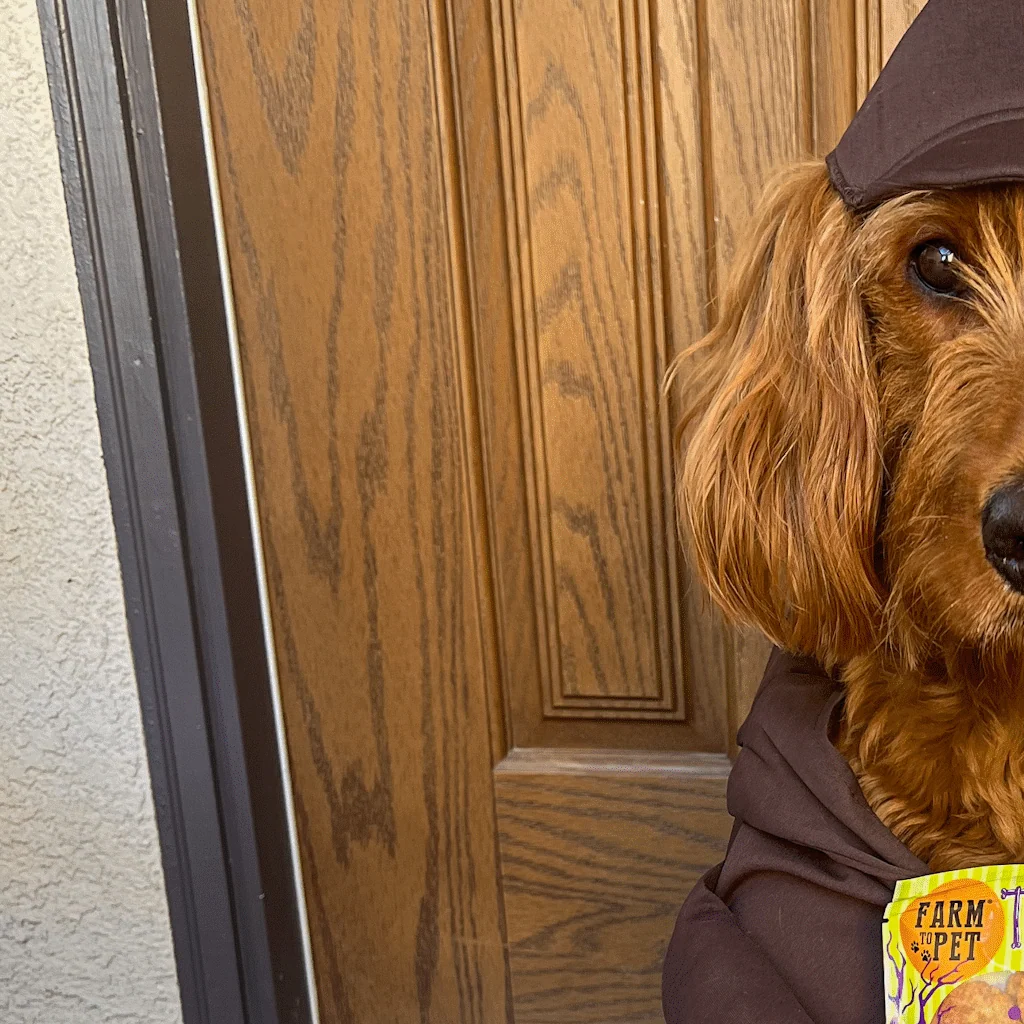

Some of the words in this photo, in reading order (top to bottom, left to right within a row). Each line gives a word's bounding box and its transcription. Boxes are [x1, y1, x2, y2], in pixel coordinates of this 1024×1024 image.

[915, 899, 985, 928] FARM
[919, 931, 933, 945] TO
[932, 931, 981, 961] PET
